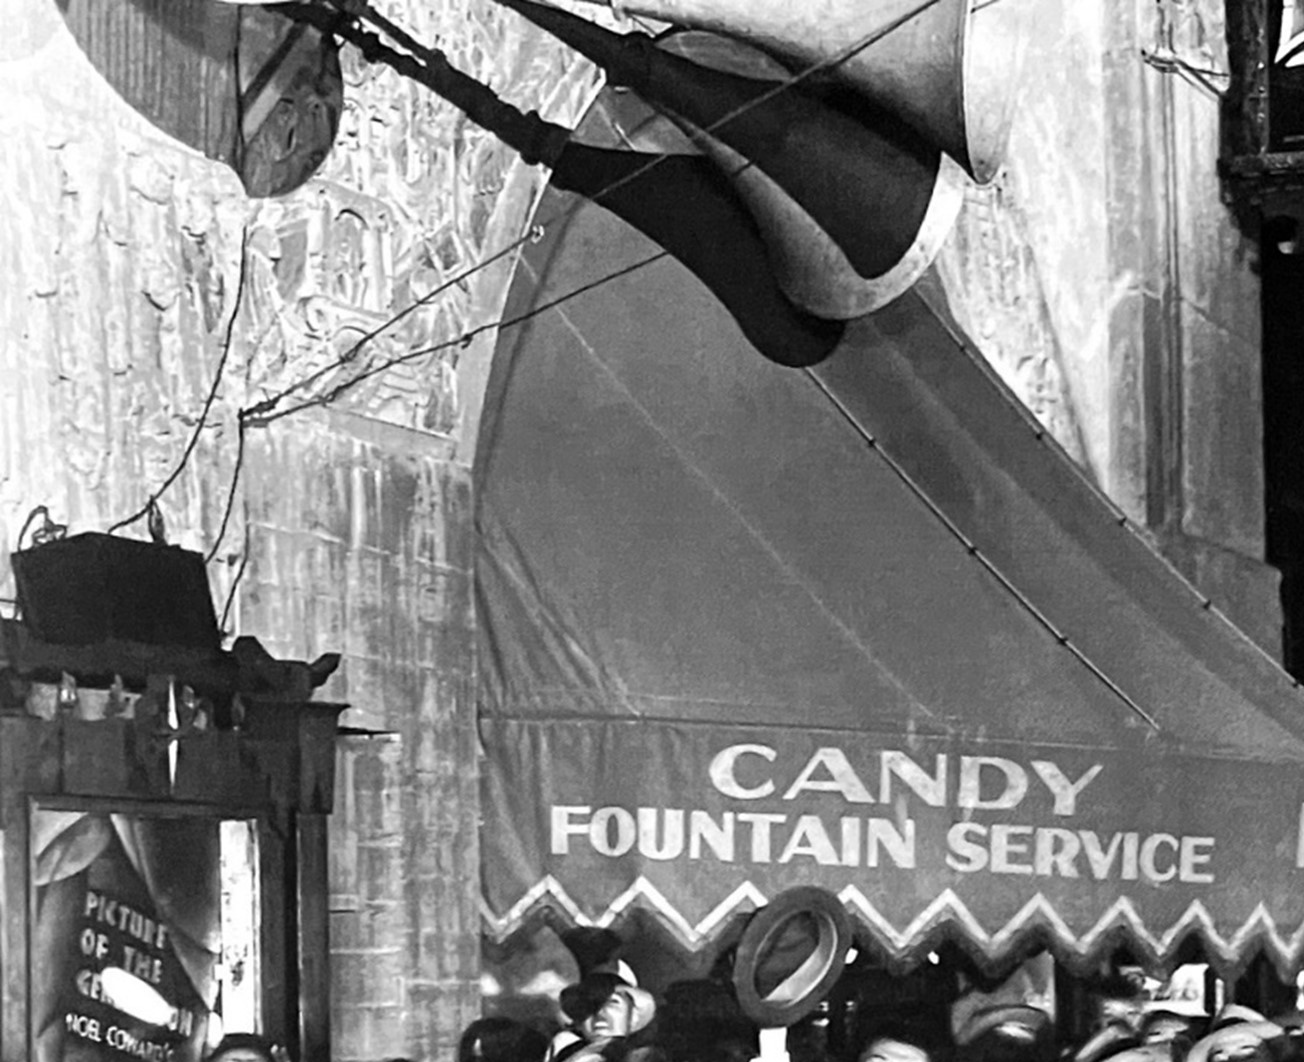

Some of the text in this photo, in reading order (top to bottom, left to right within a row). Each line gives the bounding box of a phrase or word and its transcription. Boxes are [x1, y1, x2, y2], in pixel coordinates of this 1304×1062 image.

[708, 743, 1103, 816] CANDY
[550, 805, 1215, 884] FOUNTAIN SERVICE
[80, 927, 163, 985] OF THE
